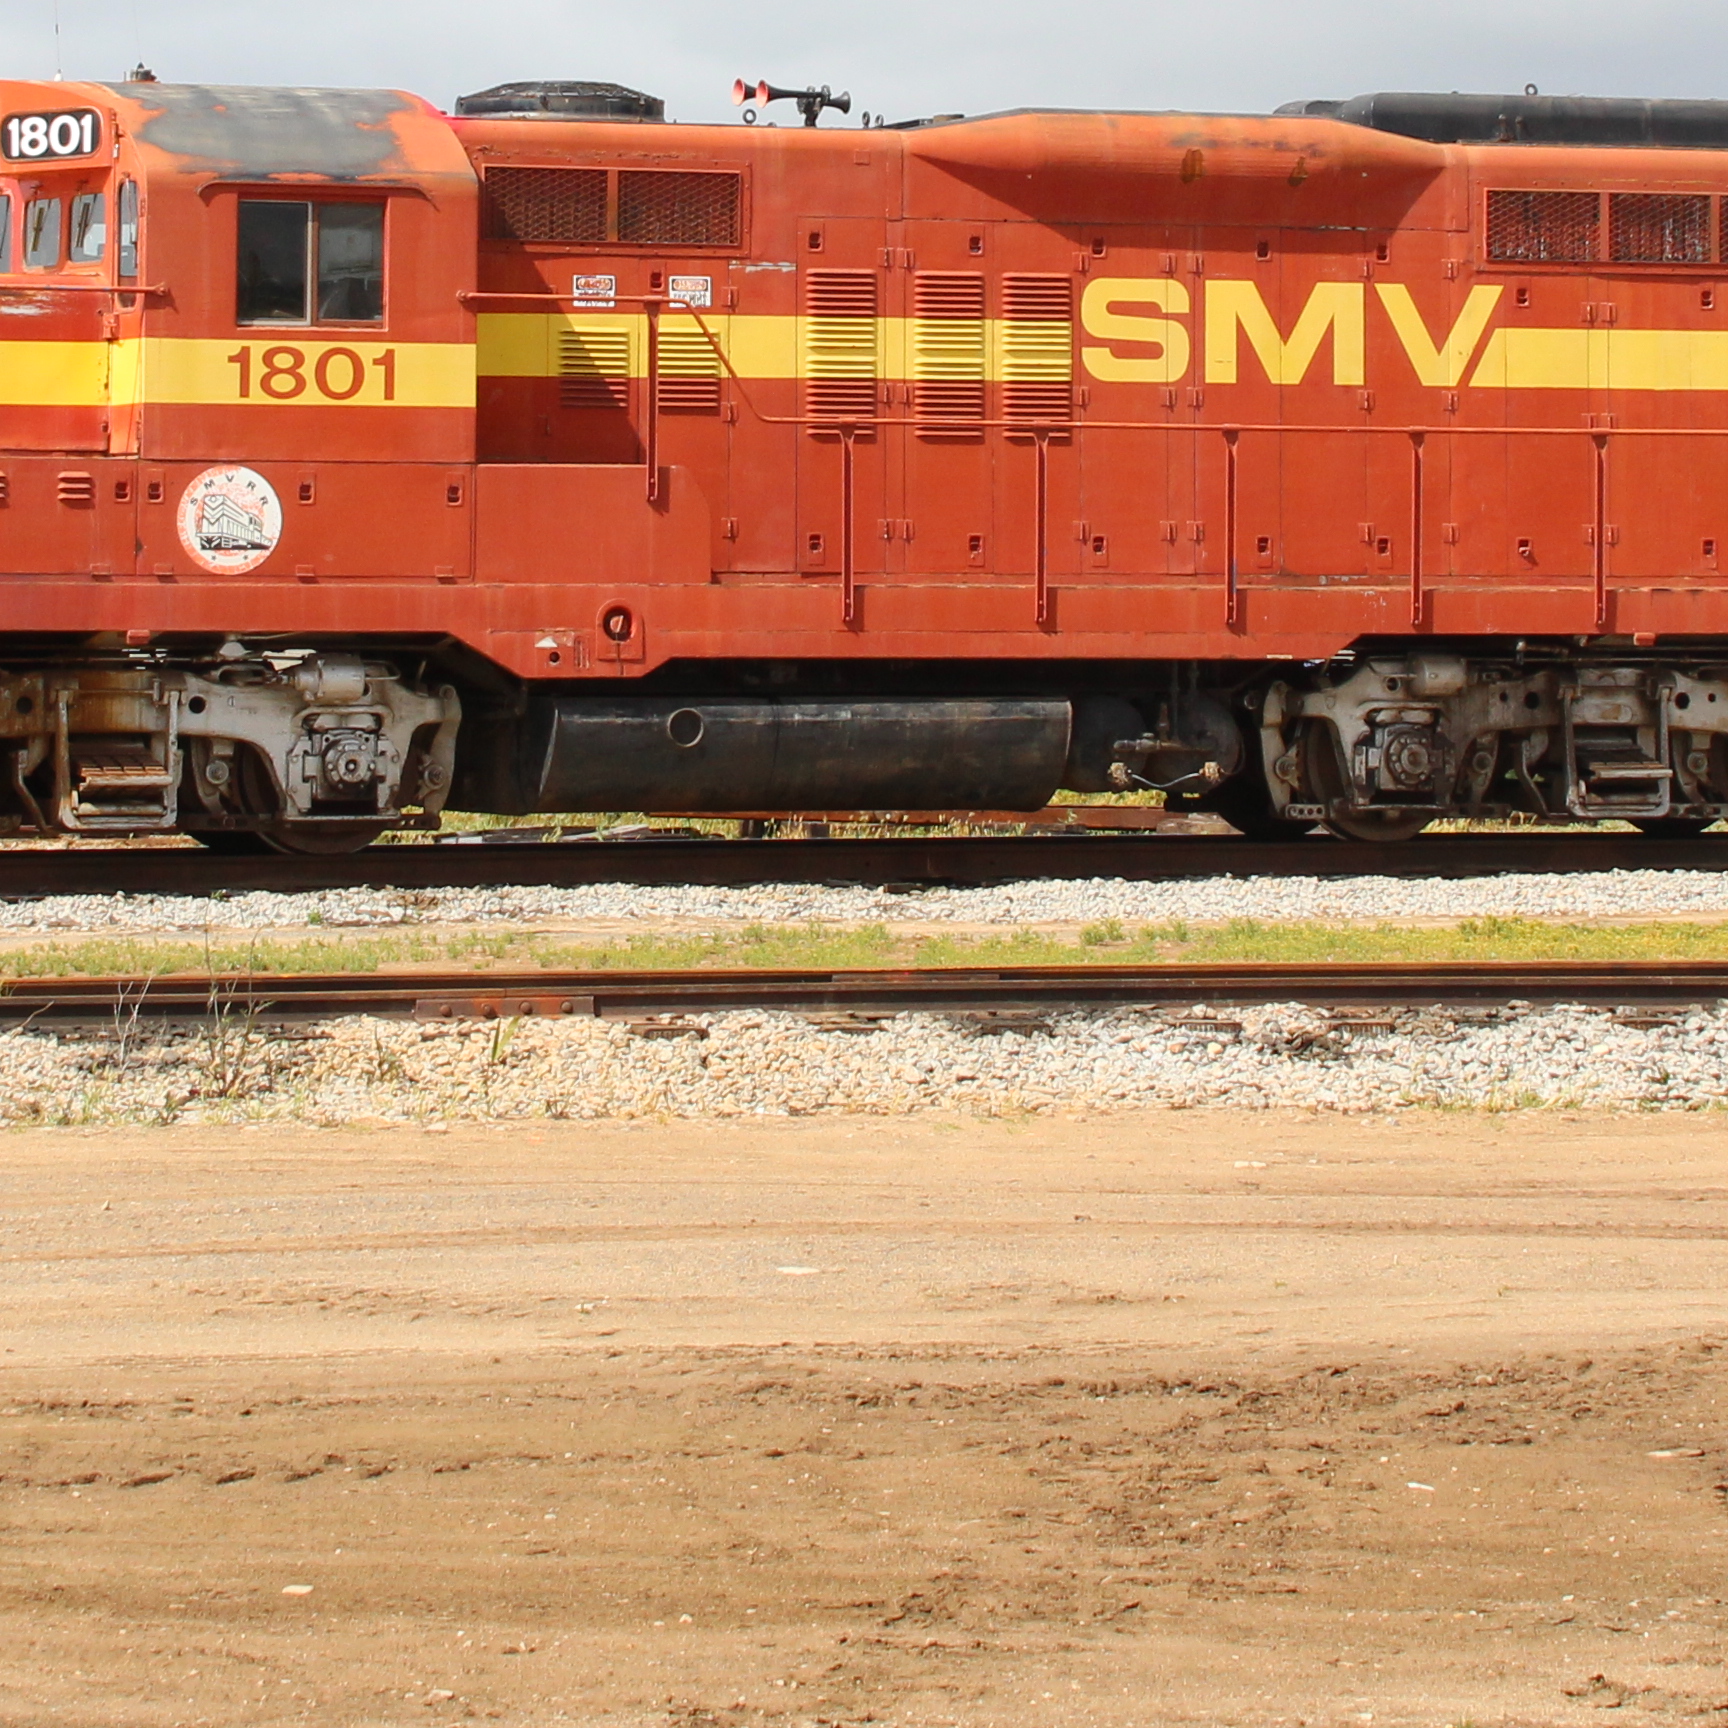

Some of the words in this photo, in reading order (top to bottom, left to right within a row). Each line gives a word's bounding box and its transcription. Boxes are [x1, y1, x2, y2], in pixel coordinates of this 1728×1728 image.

[7, 113, 93, 158] 1801
[1080, 277, 1505, 387] SMV
[227, 345, 396, 401] 1801
